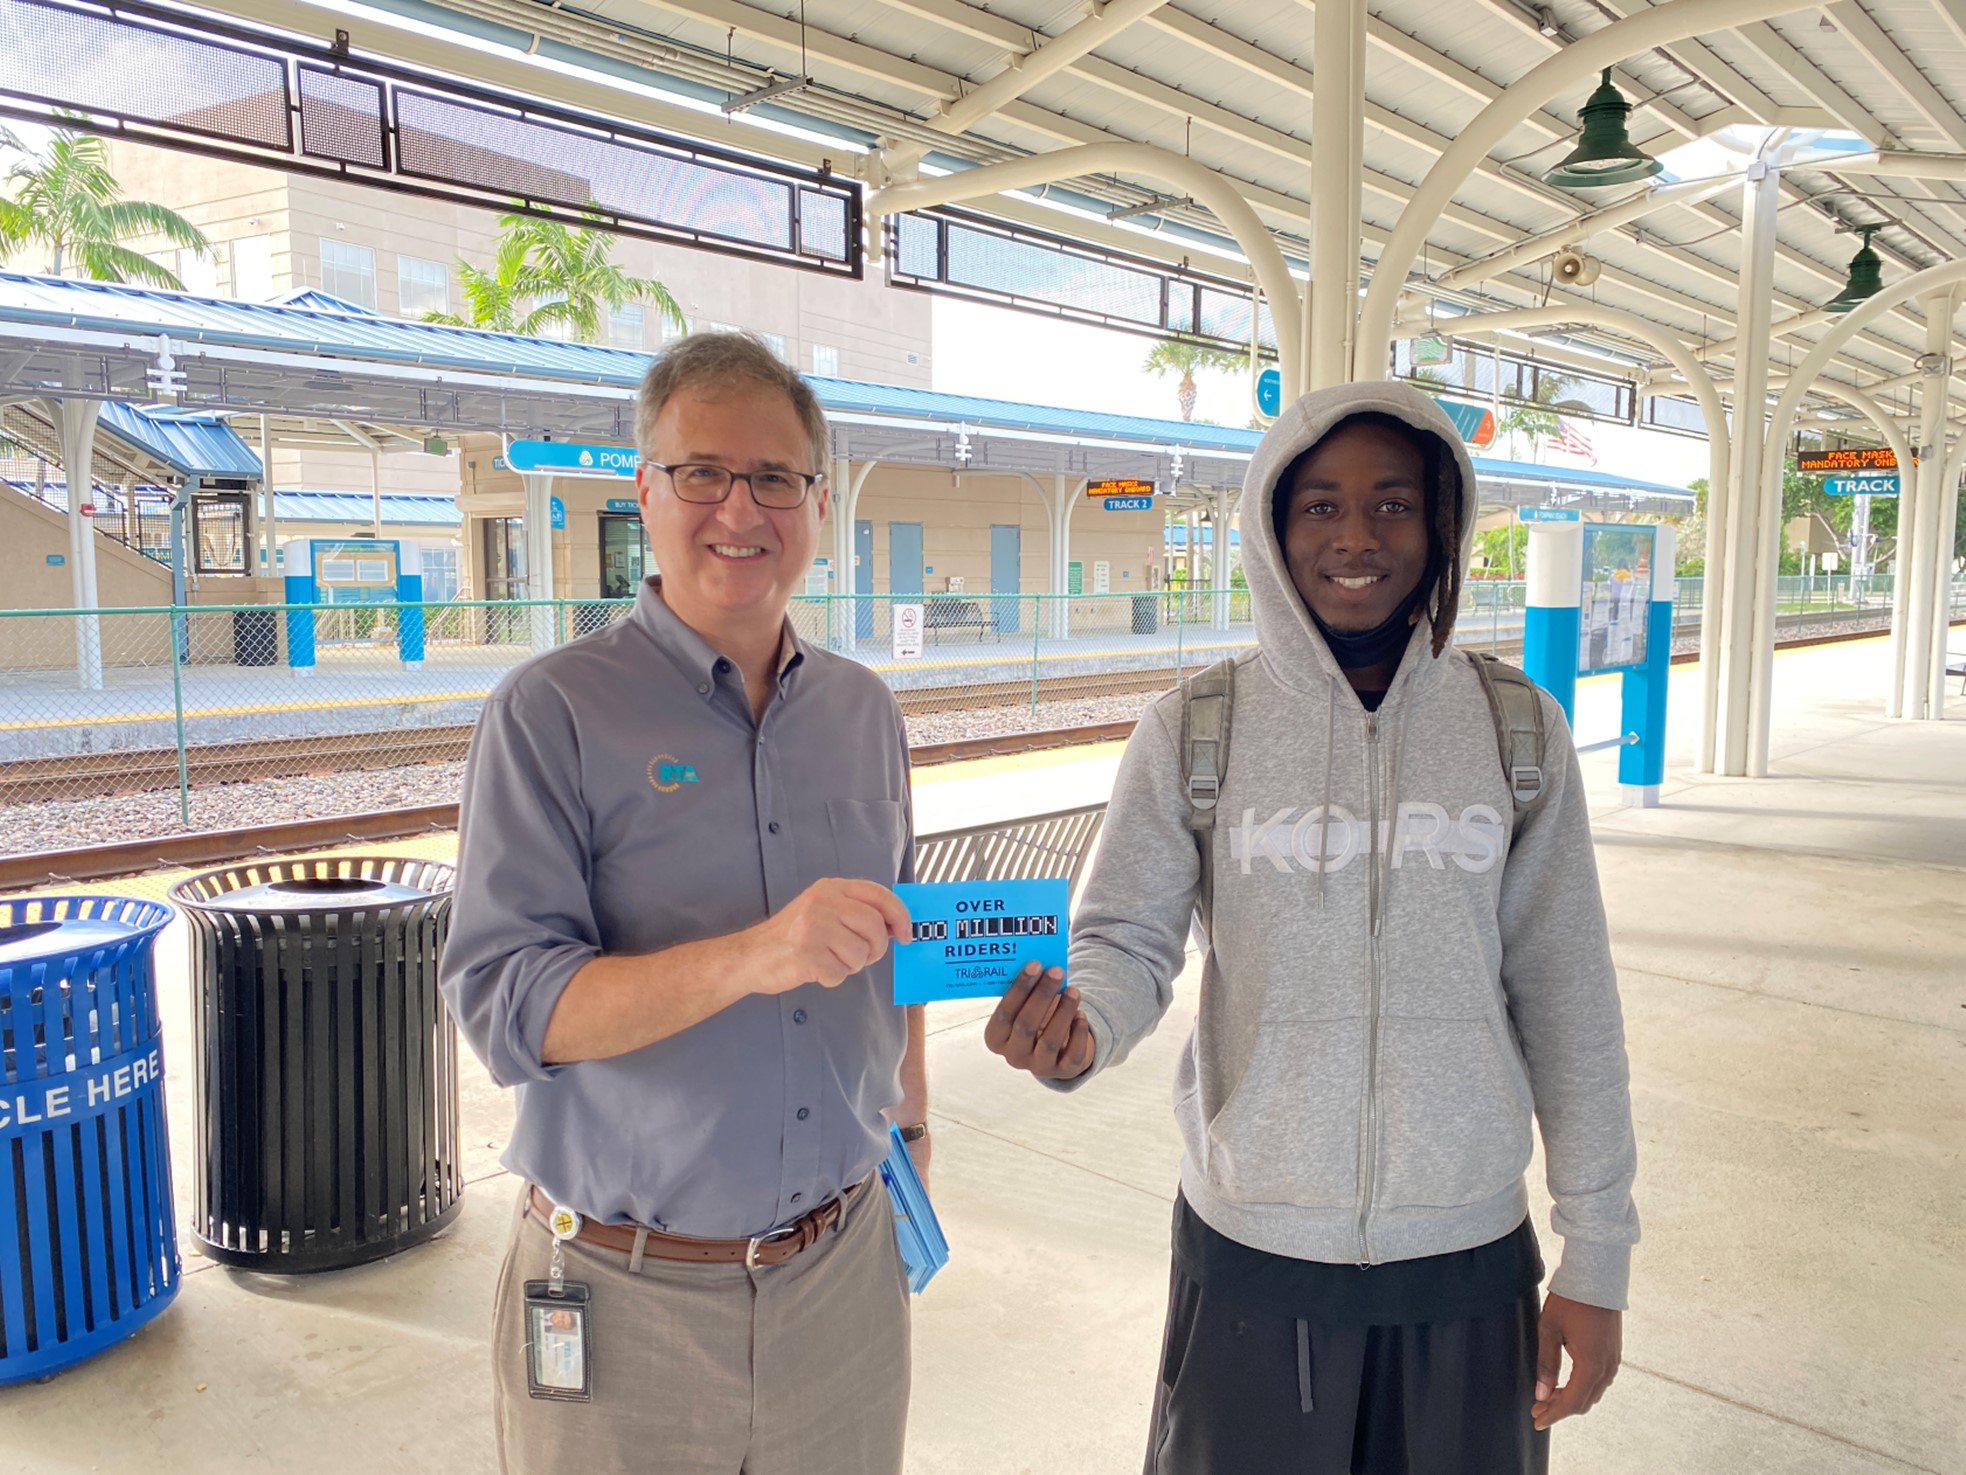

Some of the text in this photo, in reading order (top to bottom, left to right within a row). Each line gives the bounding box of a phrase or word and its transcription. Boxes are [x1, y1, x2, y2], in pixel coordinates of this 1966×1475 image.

[1828, 450, 1897, 460] FACE MASK
[1801, 459, 1869, 469] MANDATORY
[1834, 479, 1895, 492] TRACK
[1108, 499, 1148, 509] TRACK 2
[1240, 801, 1503, 875] KORS
[955, 899, 1005, 913] OVER
[956, 915, 1058, 939] MILLION
[945, 942, 1017, 957] RIDERS!
[87, 1049, 159, 1107] HERE
